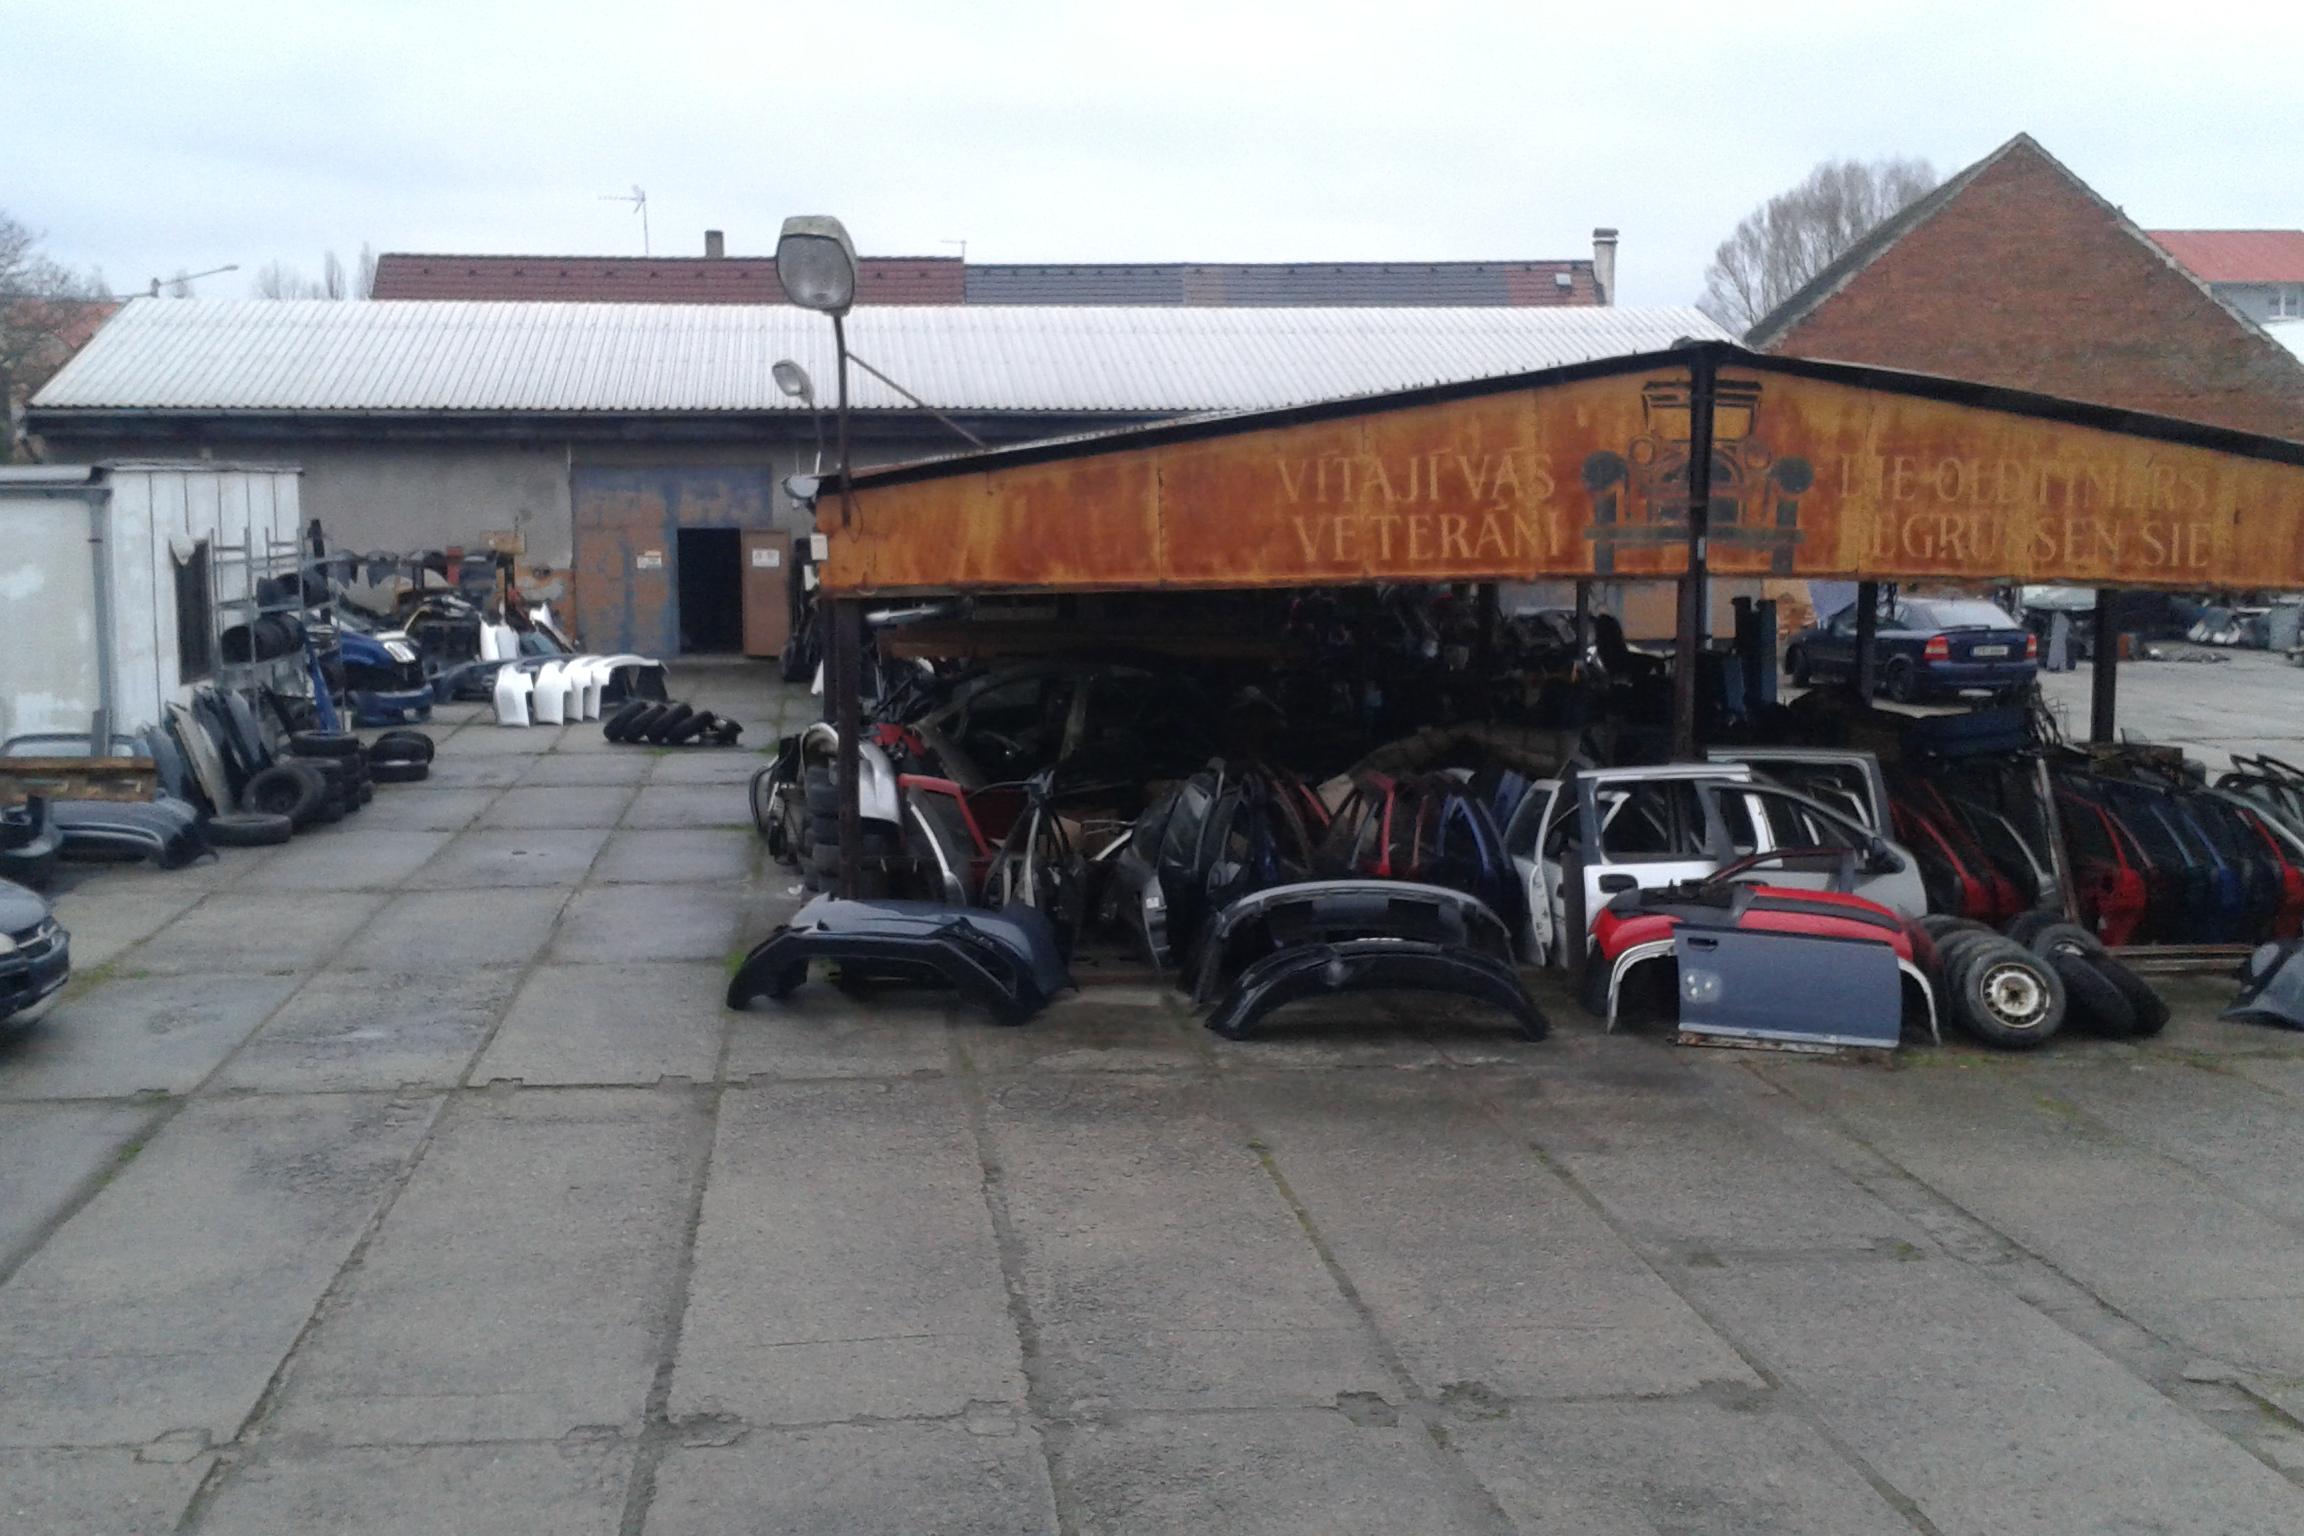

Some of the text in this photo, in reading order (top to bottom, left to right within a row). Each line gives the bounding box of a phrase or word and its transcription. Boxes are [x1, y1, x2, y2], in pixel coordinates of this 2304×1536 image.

[1456, 446, 1556, 502] VÁS
[1290, 504, 1563, 563] VETERÁNI
[2140, 520, 2213, 568] SIE
